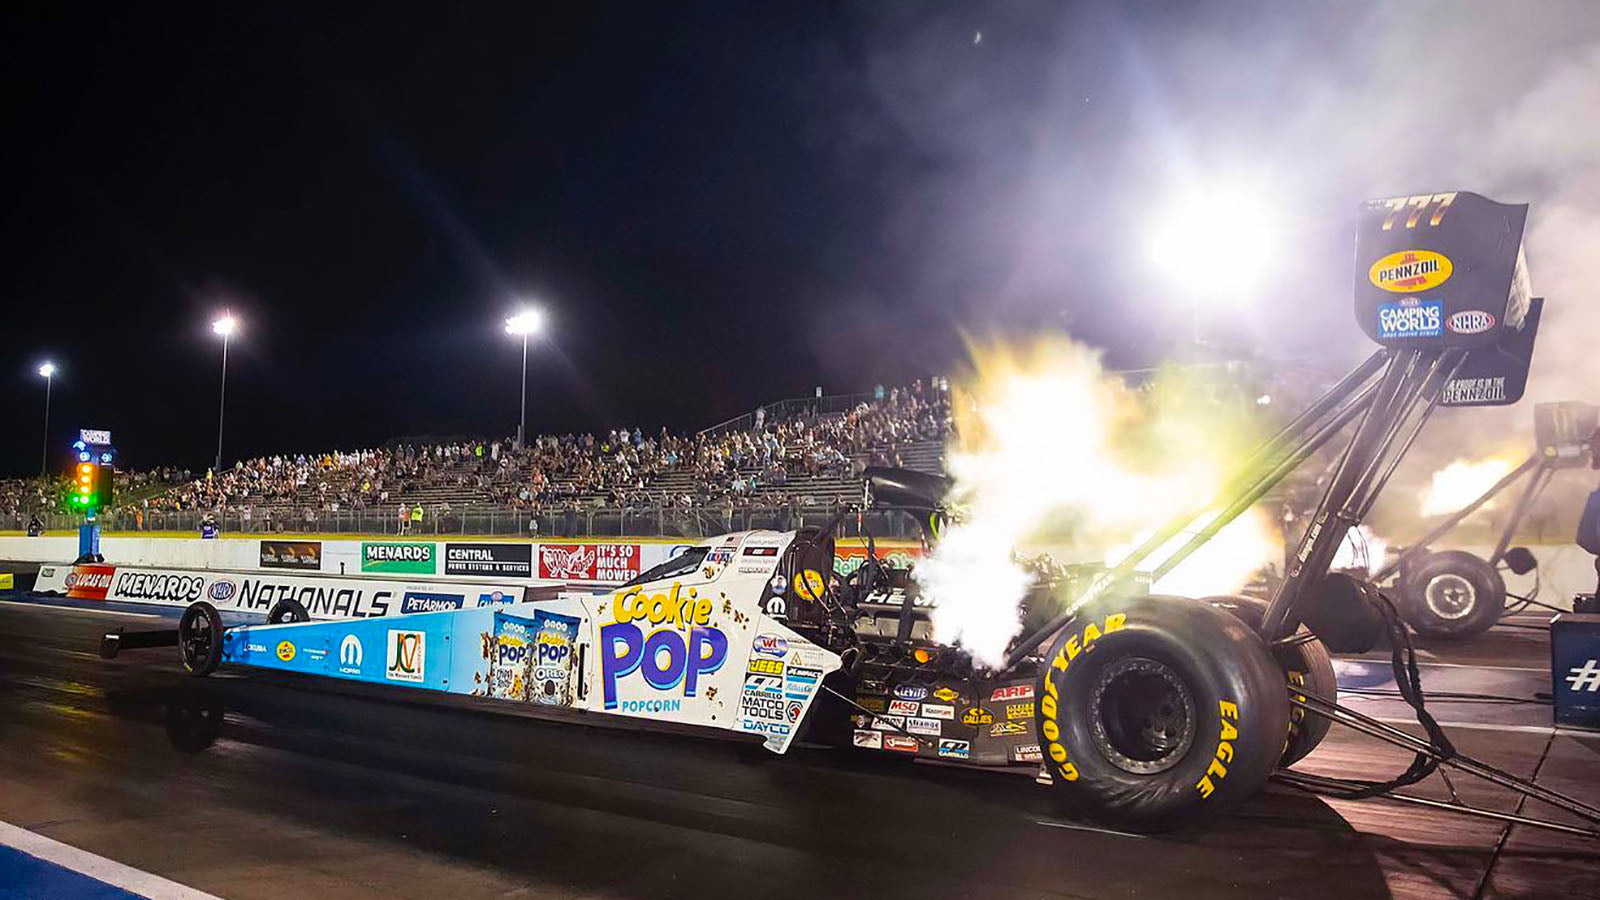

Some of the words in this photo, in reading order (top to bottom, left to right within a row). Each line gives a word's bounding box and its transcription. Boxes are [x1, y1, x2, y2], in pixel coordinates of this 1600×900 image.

[1382, 192, 1458, 230] 777
[1379, 259, 1440, 283] PENNZOIL
[1380, 306, 1440, 320] CAMPING
[1381, 317, 1440, 333] WORLD
[1452, 314, 1488, 331] NHRA
[366, 545, 431, 562] MENARDS
[448, 548, 494, 561] CENTRAL
[596, 545, 617, 557] IT'S
[619, 545, 634, 557] SO
[596, 557, 628, 569] MUCH
[596, 569, 638, 580] MOWER
[115, 572, 205, 602] MENARDS
[236, 579, 392, 618] NATIONALS
[613, 581, 713, 632] Cookie
[750, 659, 784, 675] JEGS
[744, 689, 783, 700] CARRILLO
[993, 685, 1033, 699] ARP
[622, 699, 681, 713] POPCORN
[742, 696, 784, 710] MATCO
[890, 701, 918, 712] MSD
[742, 706, 784, 720] TOOLS
[743, 719, 791, 735] DAYCO
[1196, 699, 1239, 799] EAGLE
